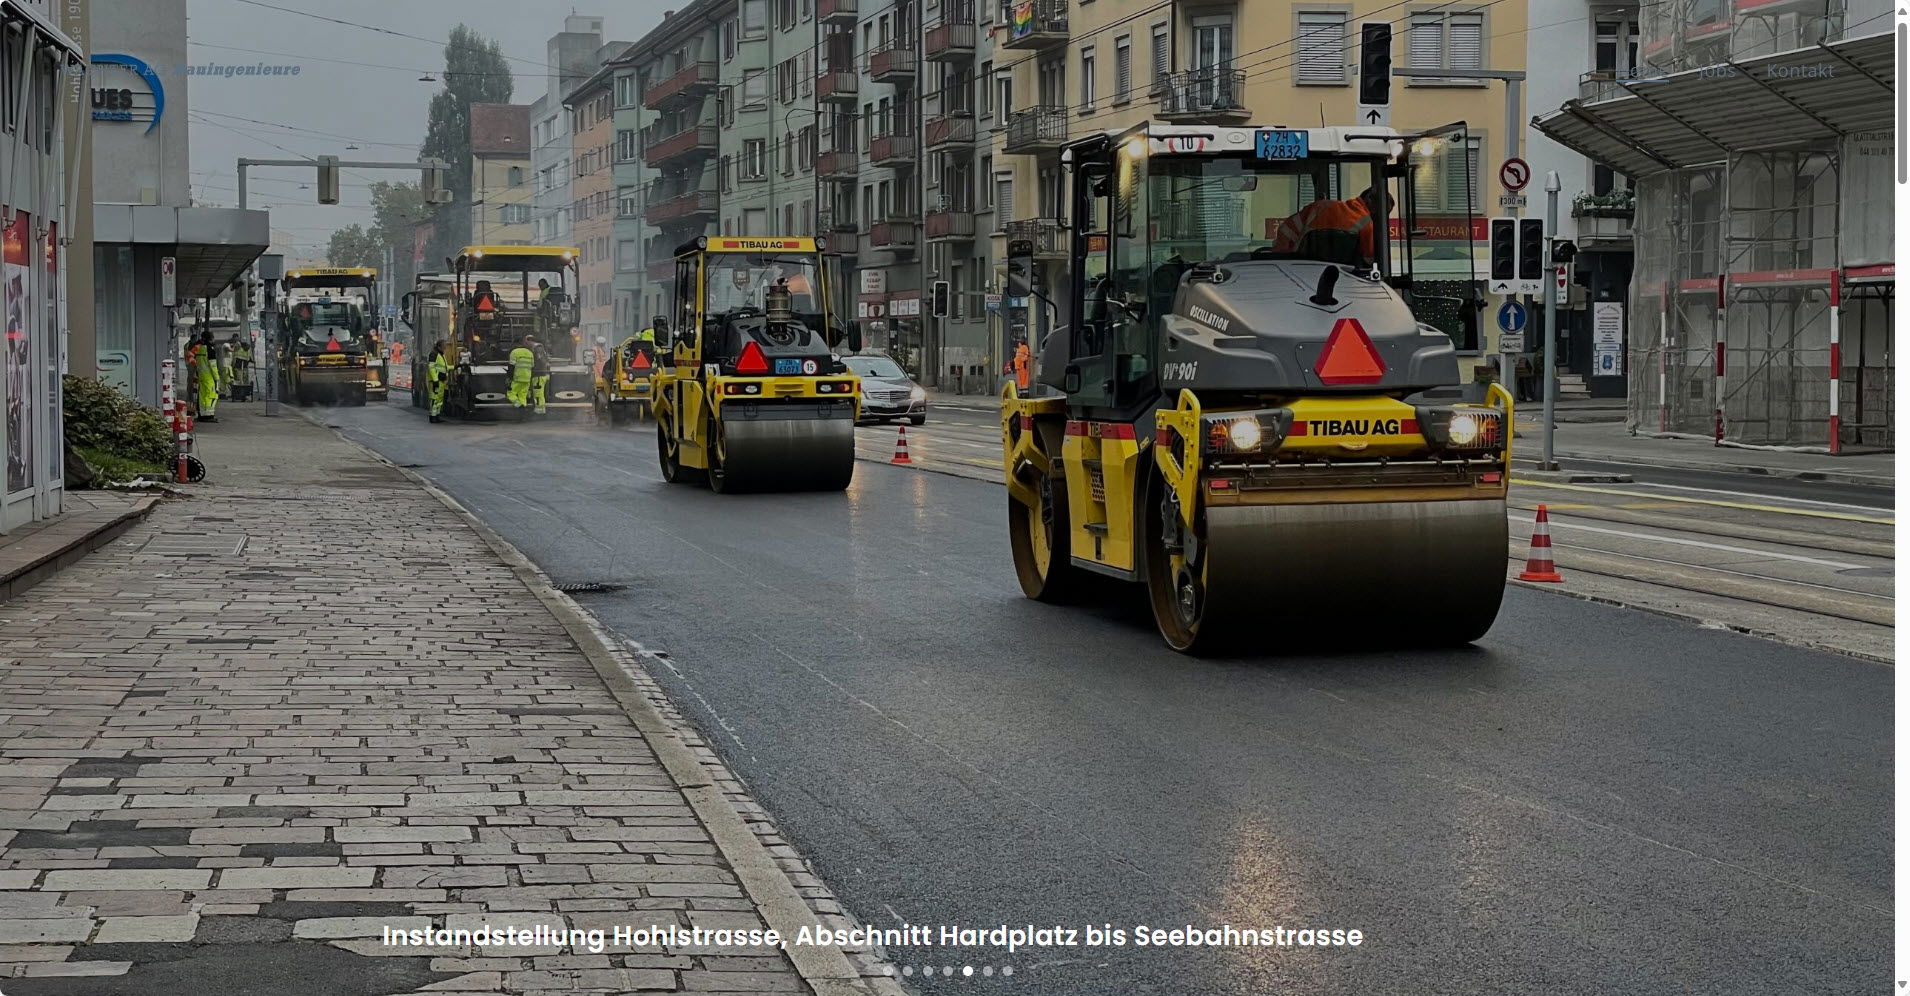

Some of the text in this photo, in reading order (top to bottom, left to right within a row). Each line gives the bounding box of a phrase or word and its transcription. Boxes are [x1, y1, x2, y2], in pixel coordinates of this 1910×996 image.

[1263, 144, 1301, 159] 62832
[1503, 197, 1516, 205] 300
[740, 240, 783, 249] TIBAU AG
[1189, 305, 1230, 331] OSCILLATION
[806, 363, 814, 371] 15
[1309, 418, 1400, 437] TIBAU AG
